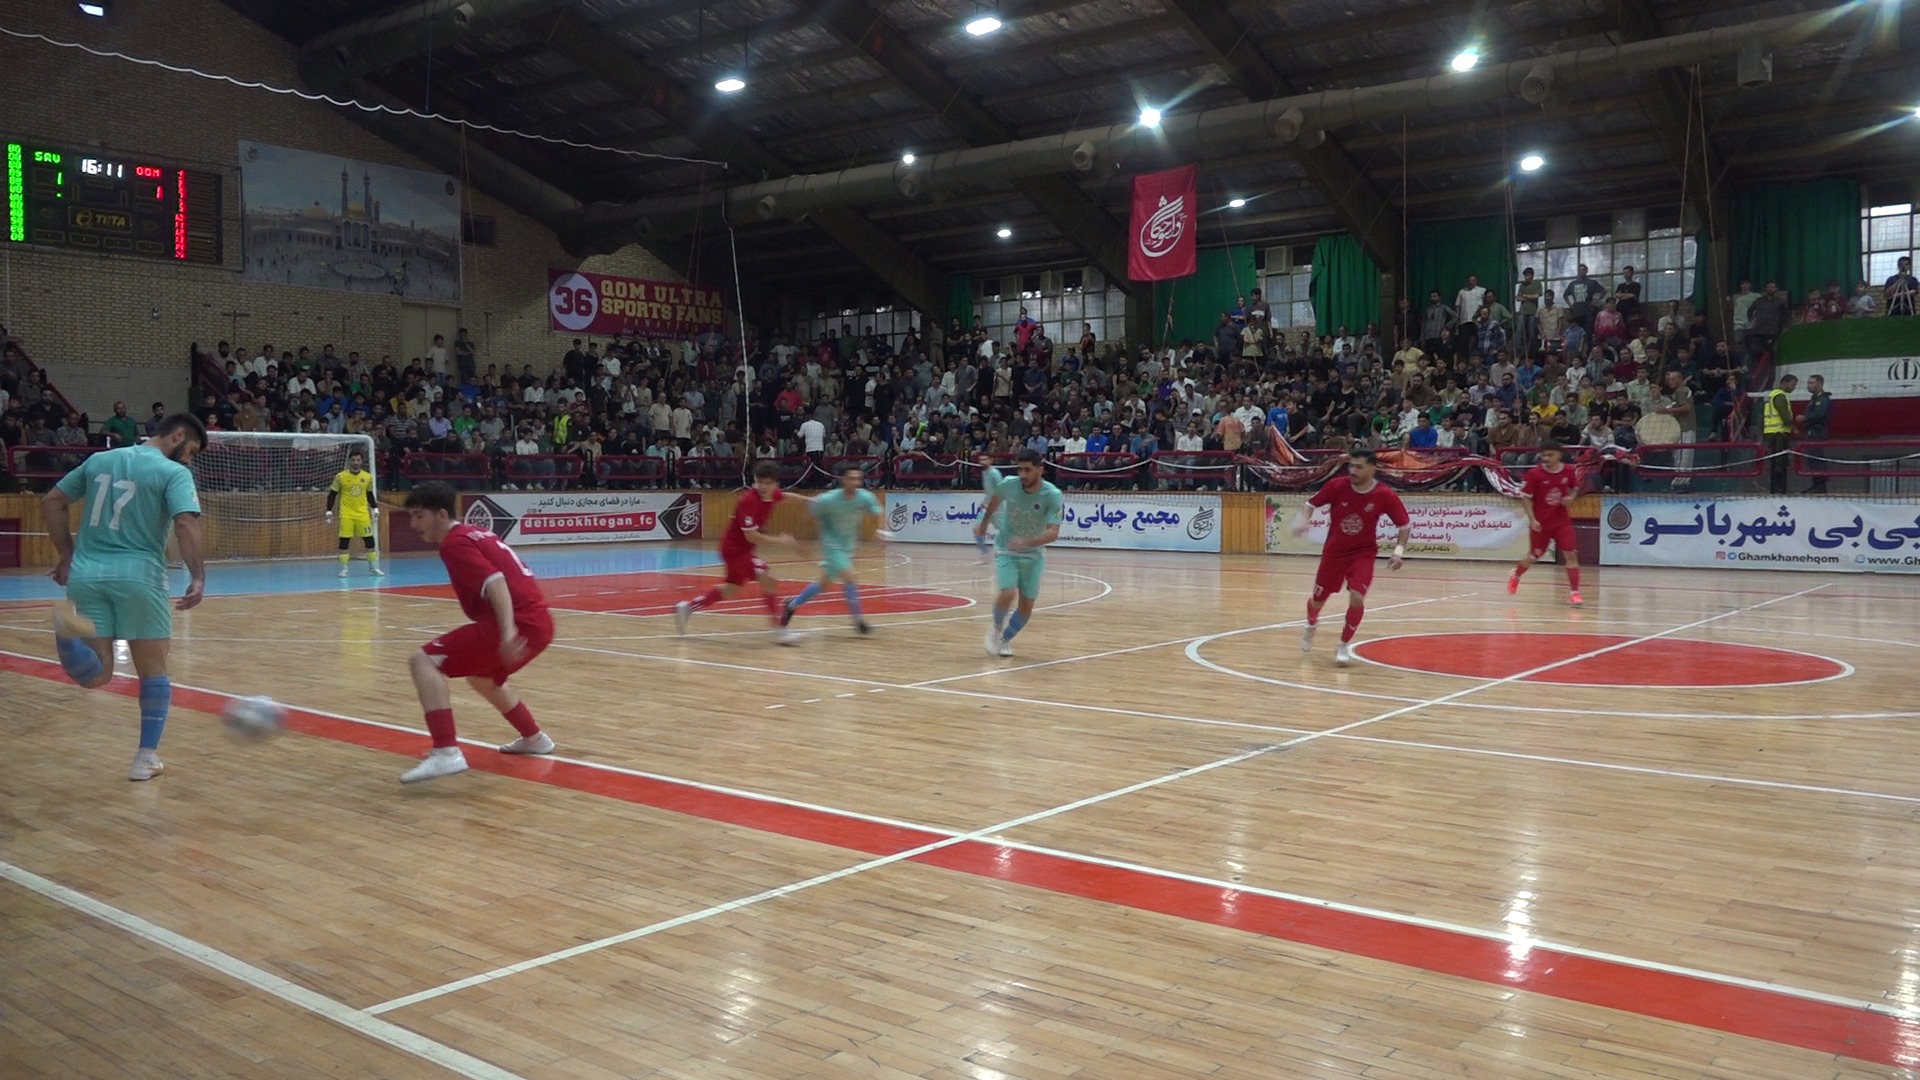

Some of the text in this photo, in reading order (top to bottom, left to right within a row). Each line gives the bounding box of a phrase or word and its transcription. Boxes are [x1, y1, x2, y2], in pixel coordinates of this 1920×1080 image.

[81, 159, 123, 178] 16:11
[57, 172, 63, 186] 1
[156, 185, 163, 200] 1
[555, 286, 593, 317] 36
[601, 279, 723, 308] QOM ULTRA
[601, 298, 722, 325] SPORTS FANS
[89, 473, 136, 531] 17
[912, 500, 928, 525] قم
[1077, 503, 1128, 530] جهانی
[1132, 508, 1180, 532] مجمع
[1428, 507, 1463, 517] مسئولین
[1464, 507, 1487, 518] حضور
[524, 515, 654, 529] delsookhtegan_fc
[1445, 521, 1470, 530] محترم
[1471, 519, 1512, 530] نمایندگان
[1639, 502, 1797, 548] شهربانو
[1738, 551, 1840, 565] Ghamkhanehqom
